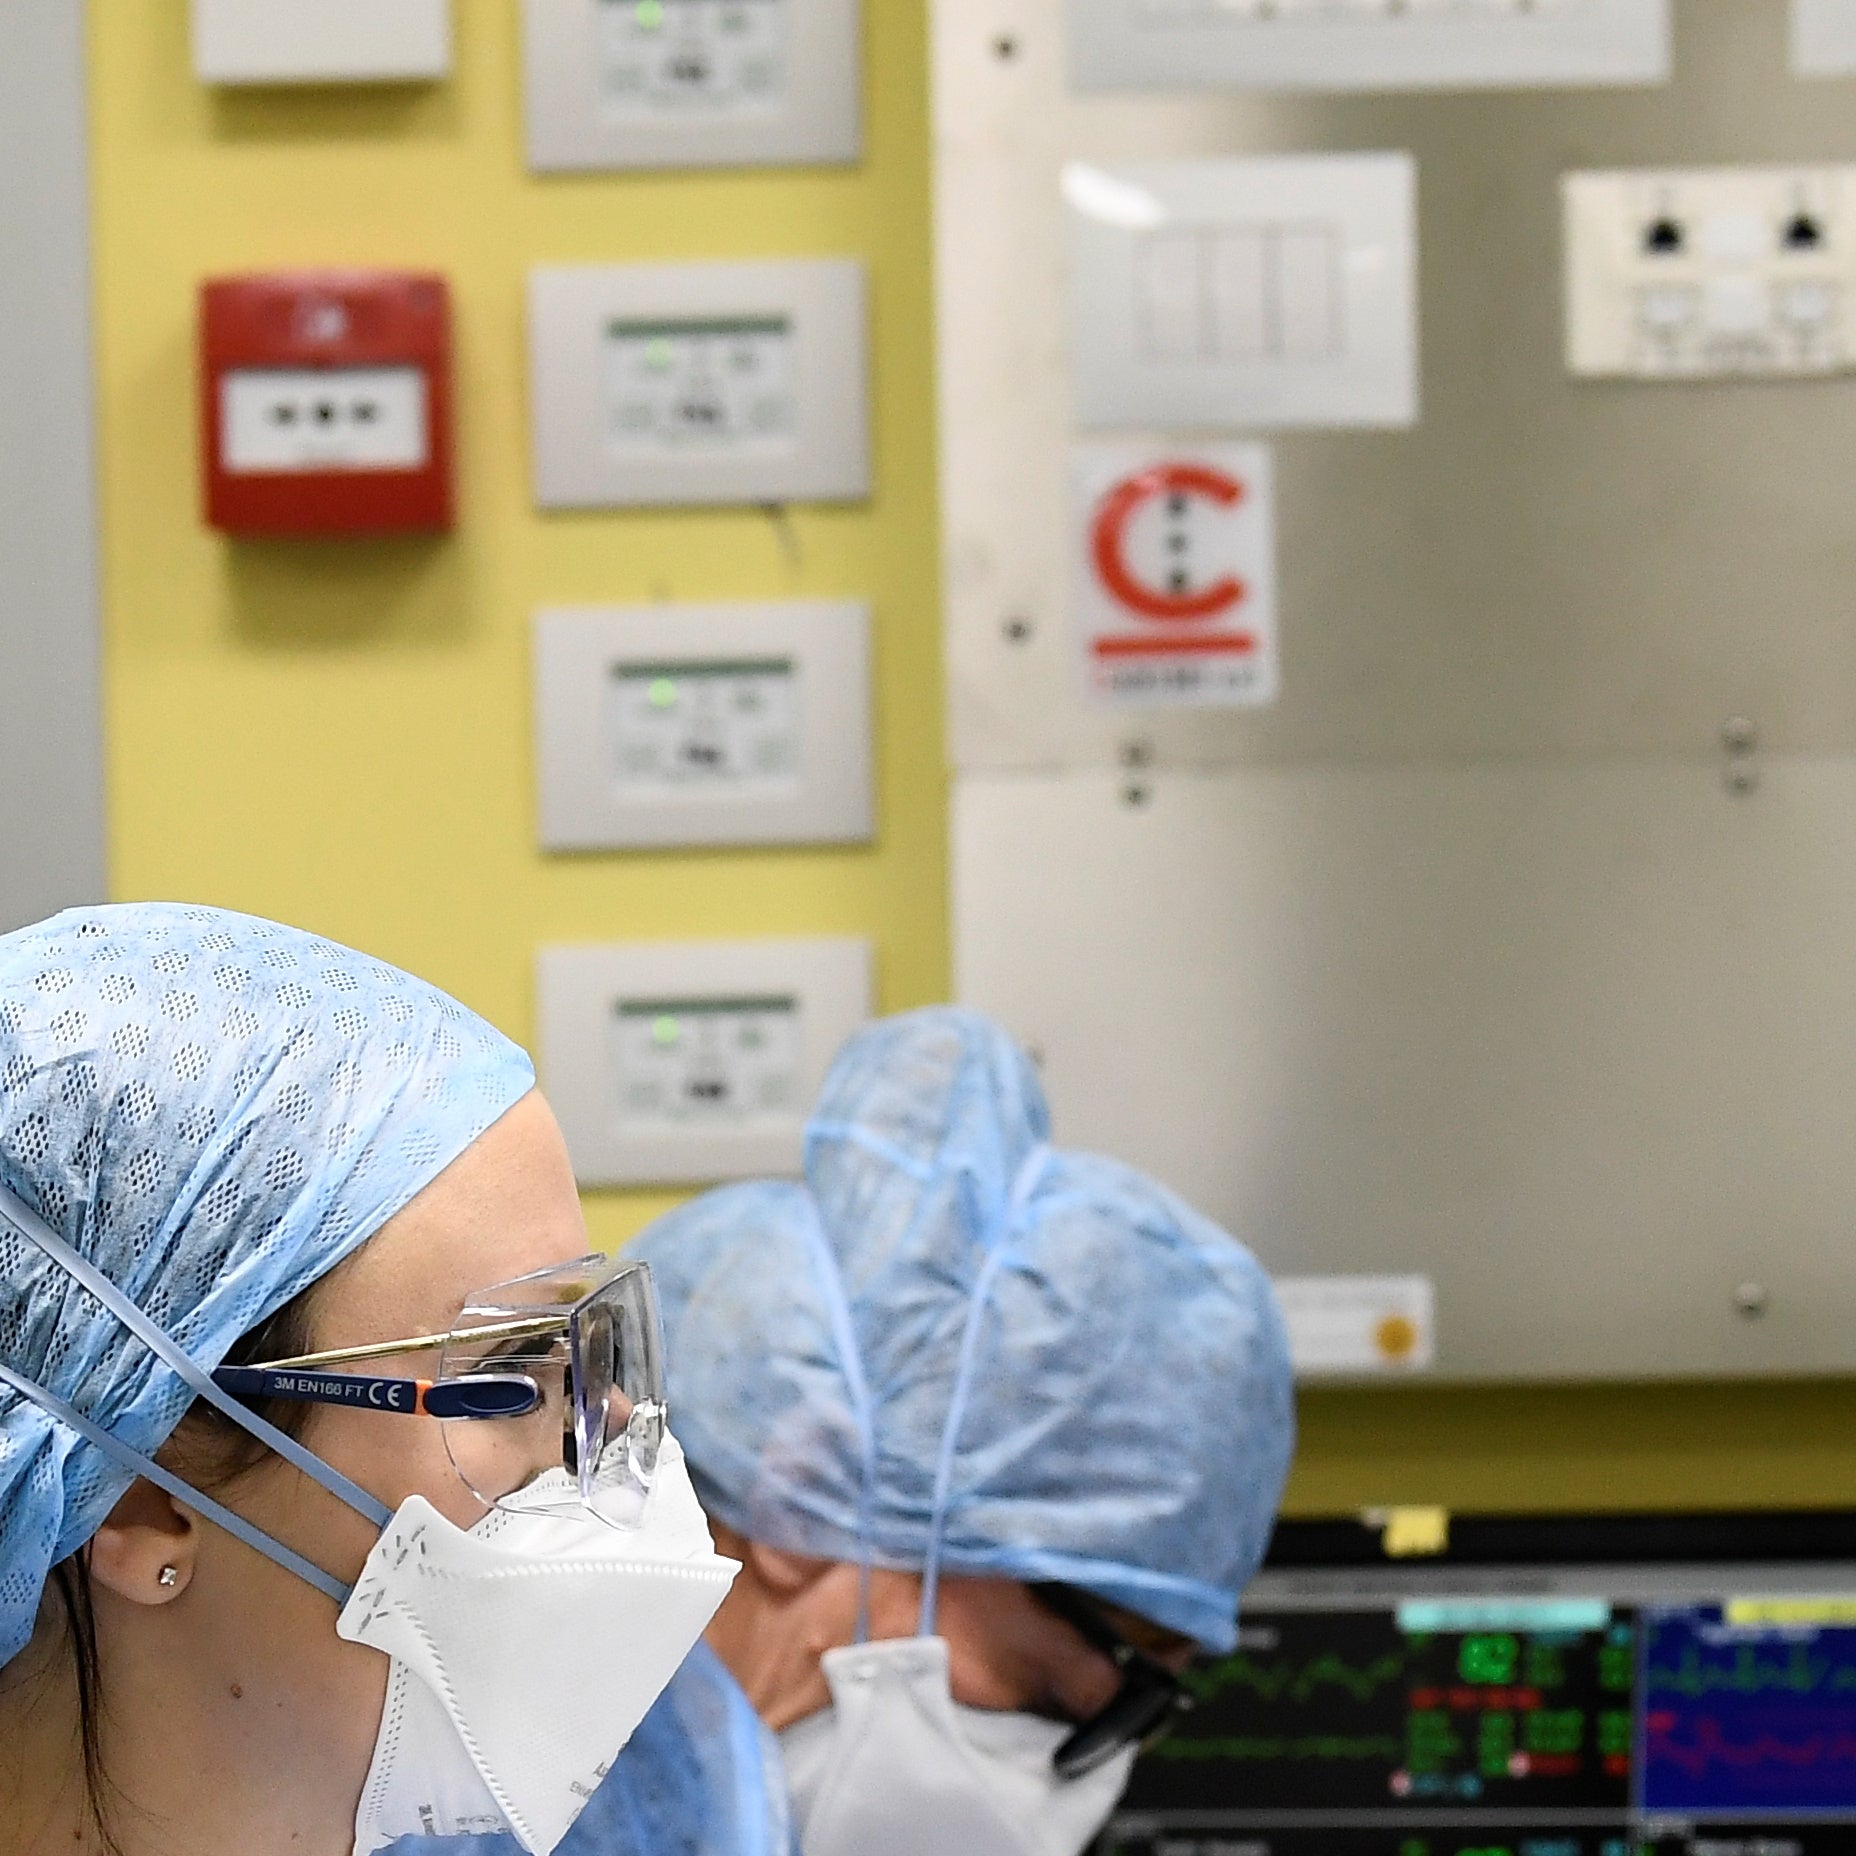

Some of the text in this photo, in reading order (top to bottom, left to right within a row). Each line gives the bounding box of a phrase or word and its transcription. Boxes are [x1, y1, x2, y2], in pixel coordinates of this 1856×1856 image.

[274, 1377, 295, 1391] 3M
[345, 1384, 364, 1398] FT
[368, 1381, 403, 1407] CE
